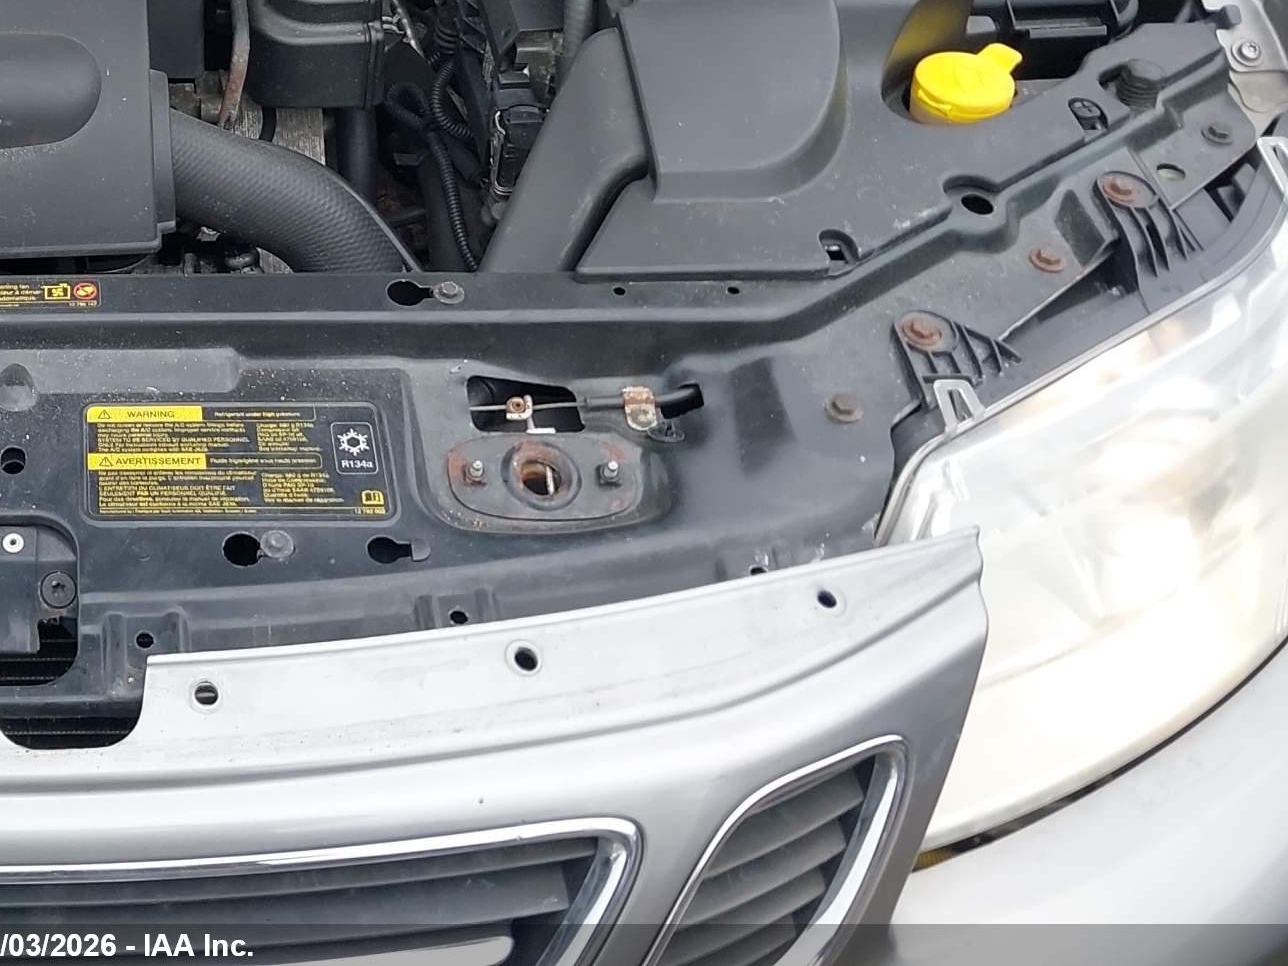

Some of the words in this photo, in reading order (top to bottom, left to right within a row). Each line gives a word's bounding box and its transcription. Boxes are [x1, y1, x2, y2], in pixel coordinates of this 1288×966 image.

[127, 410, 175, 418] WARNING
[116, 457, 201, 465] AVERTISSEMENT
[341, 459, 374, 469] R134a
